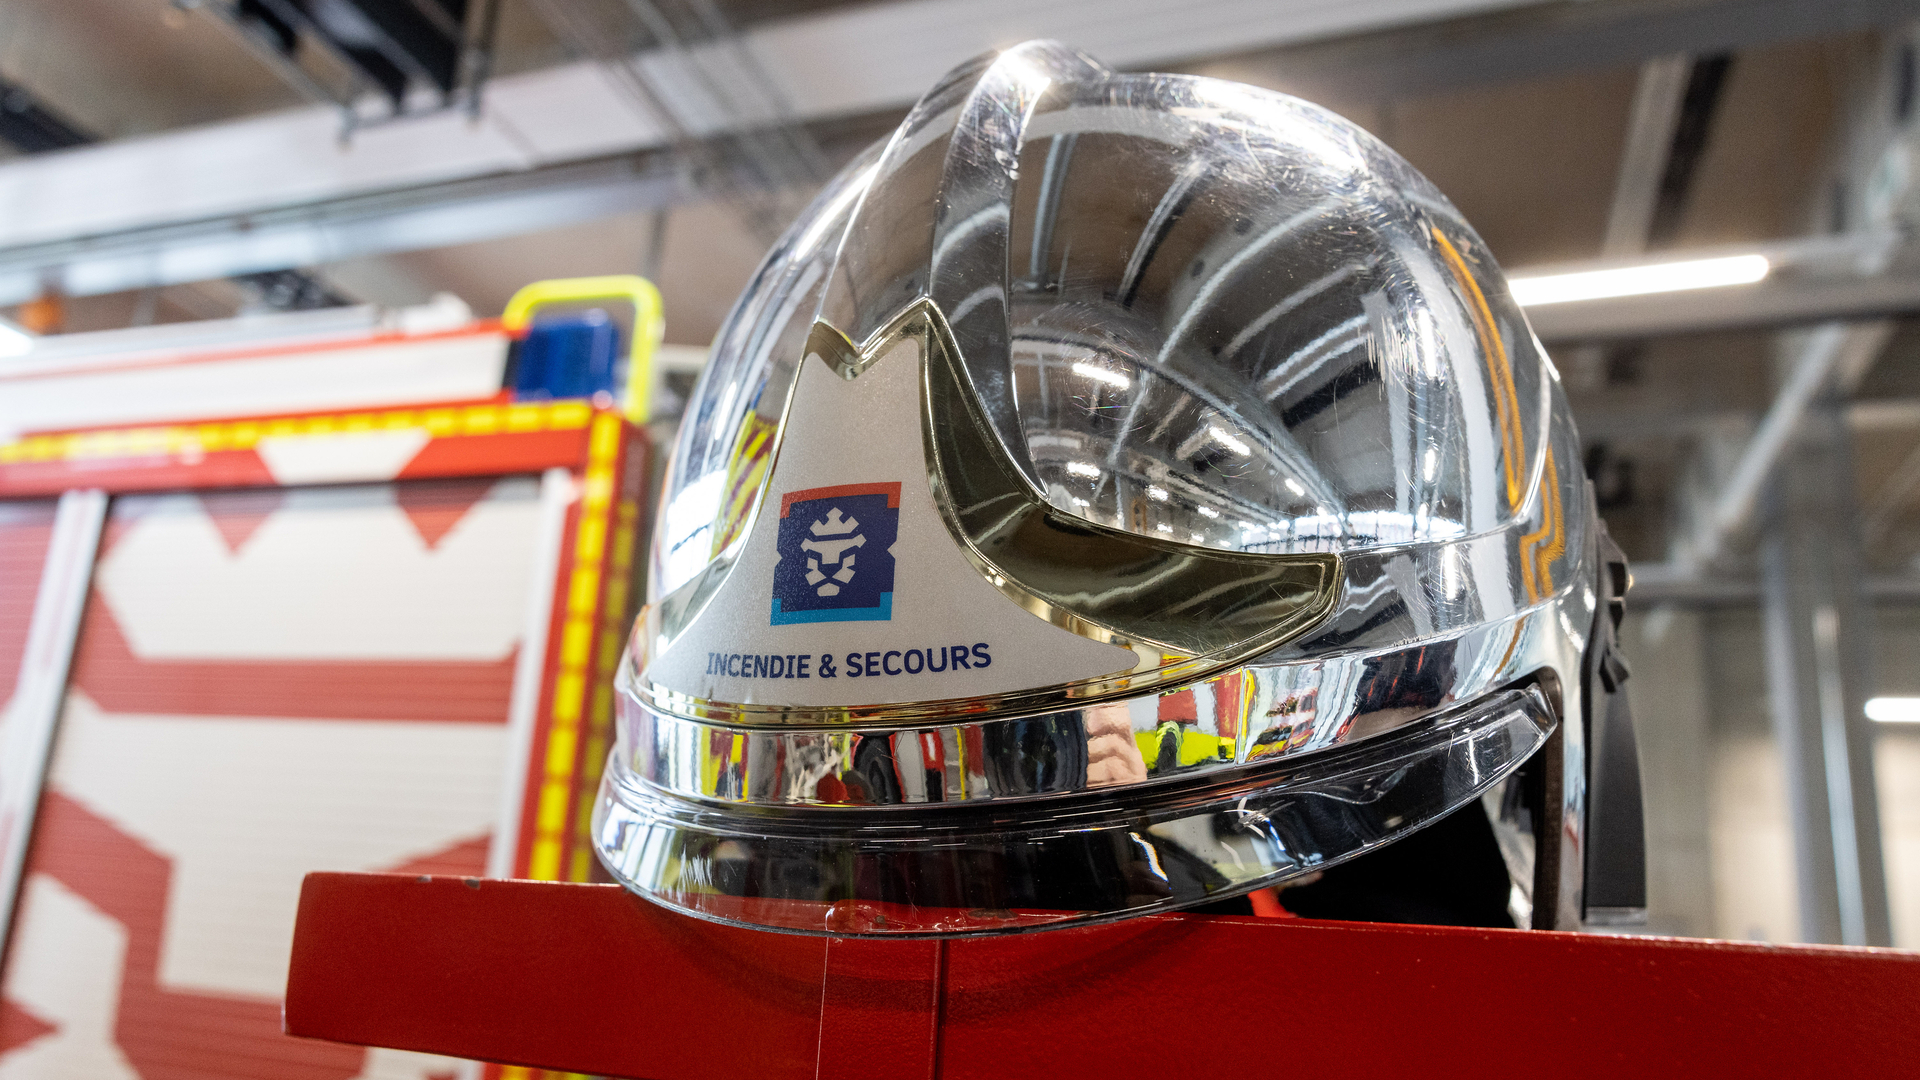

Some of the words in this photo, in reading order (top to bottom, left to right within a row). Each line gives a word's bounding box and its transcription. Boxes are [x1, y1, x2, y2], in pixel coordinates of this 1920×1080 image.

[706, 652, 811, 678] INCENDIE
[818, 653, 837, 678] &
[846, 642, 992, 678] SECOURS
